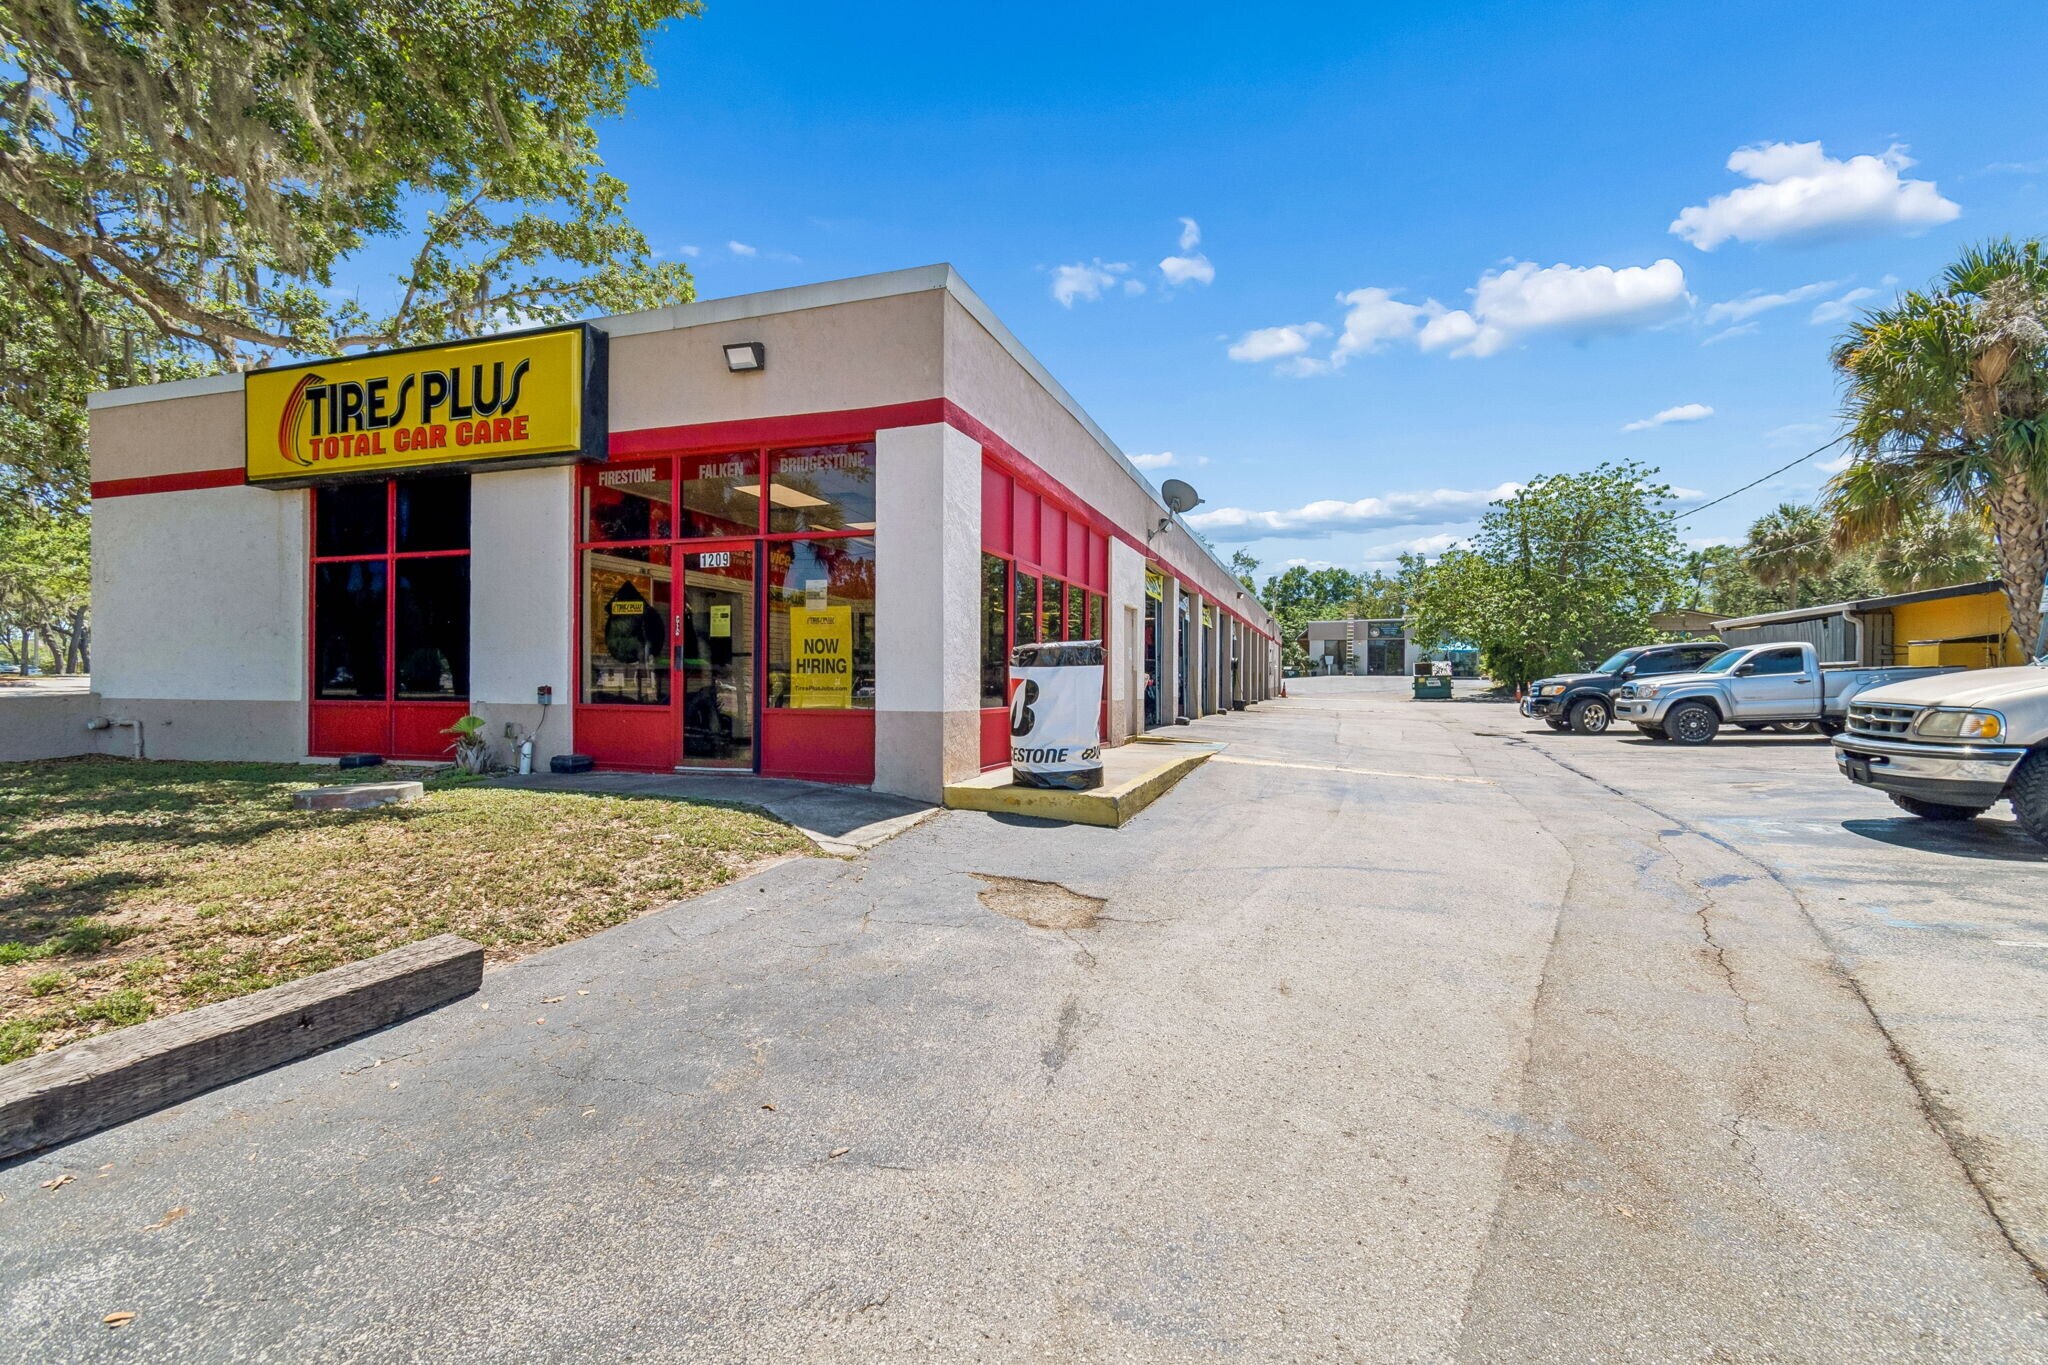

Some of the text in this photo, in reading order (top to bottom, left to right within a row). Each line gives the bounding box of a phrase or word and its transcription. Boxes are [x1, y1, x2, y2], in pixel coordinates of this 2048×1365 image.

[305, 358, 530, 436] TIRES PLUS
[310, 415, 530, 461] TOTAL CAR CARE
[698, 462, 743, 479] FALKEN
[780, 451, 866, 474] BRIDGESTONE
[598, 467, 656, 486] FIRESTONE
[701, 552, 729, 568] 1209
[804, 638, 839, 655] NOW
[796, 658, 847, 674] HIRING
[1011, 747, 1069, 764] ESTONE
